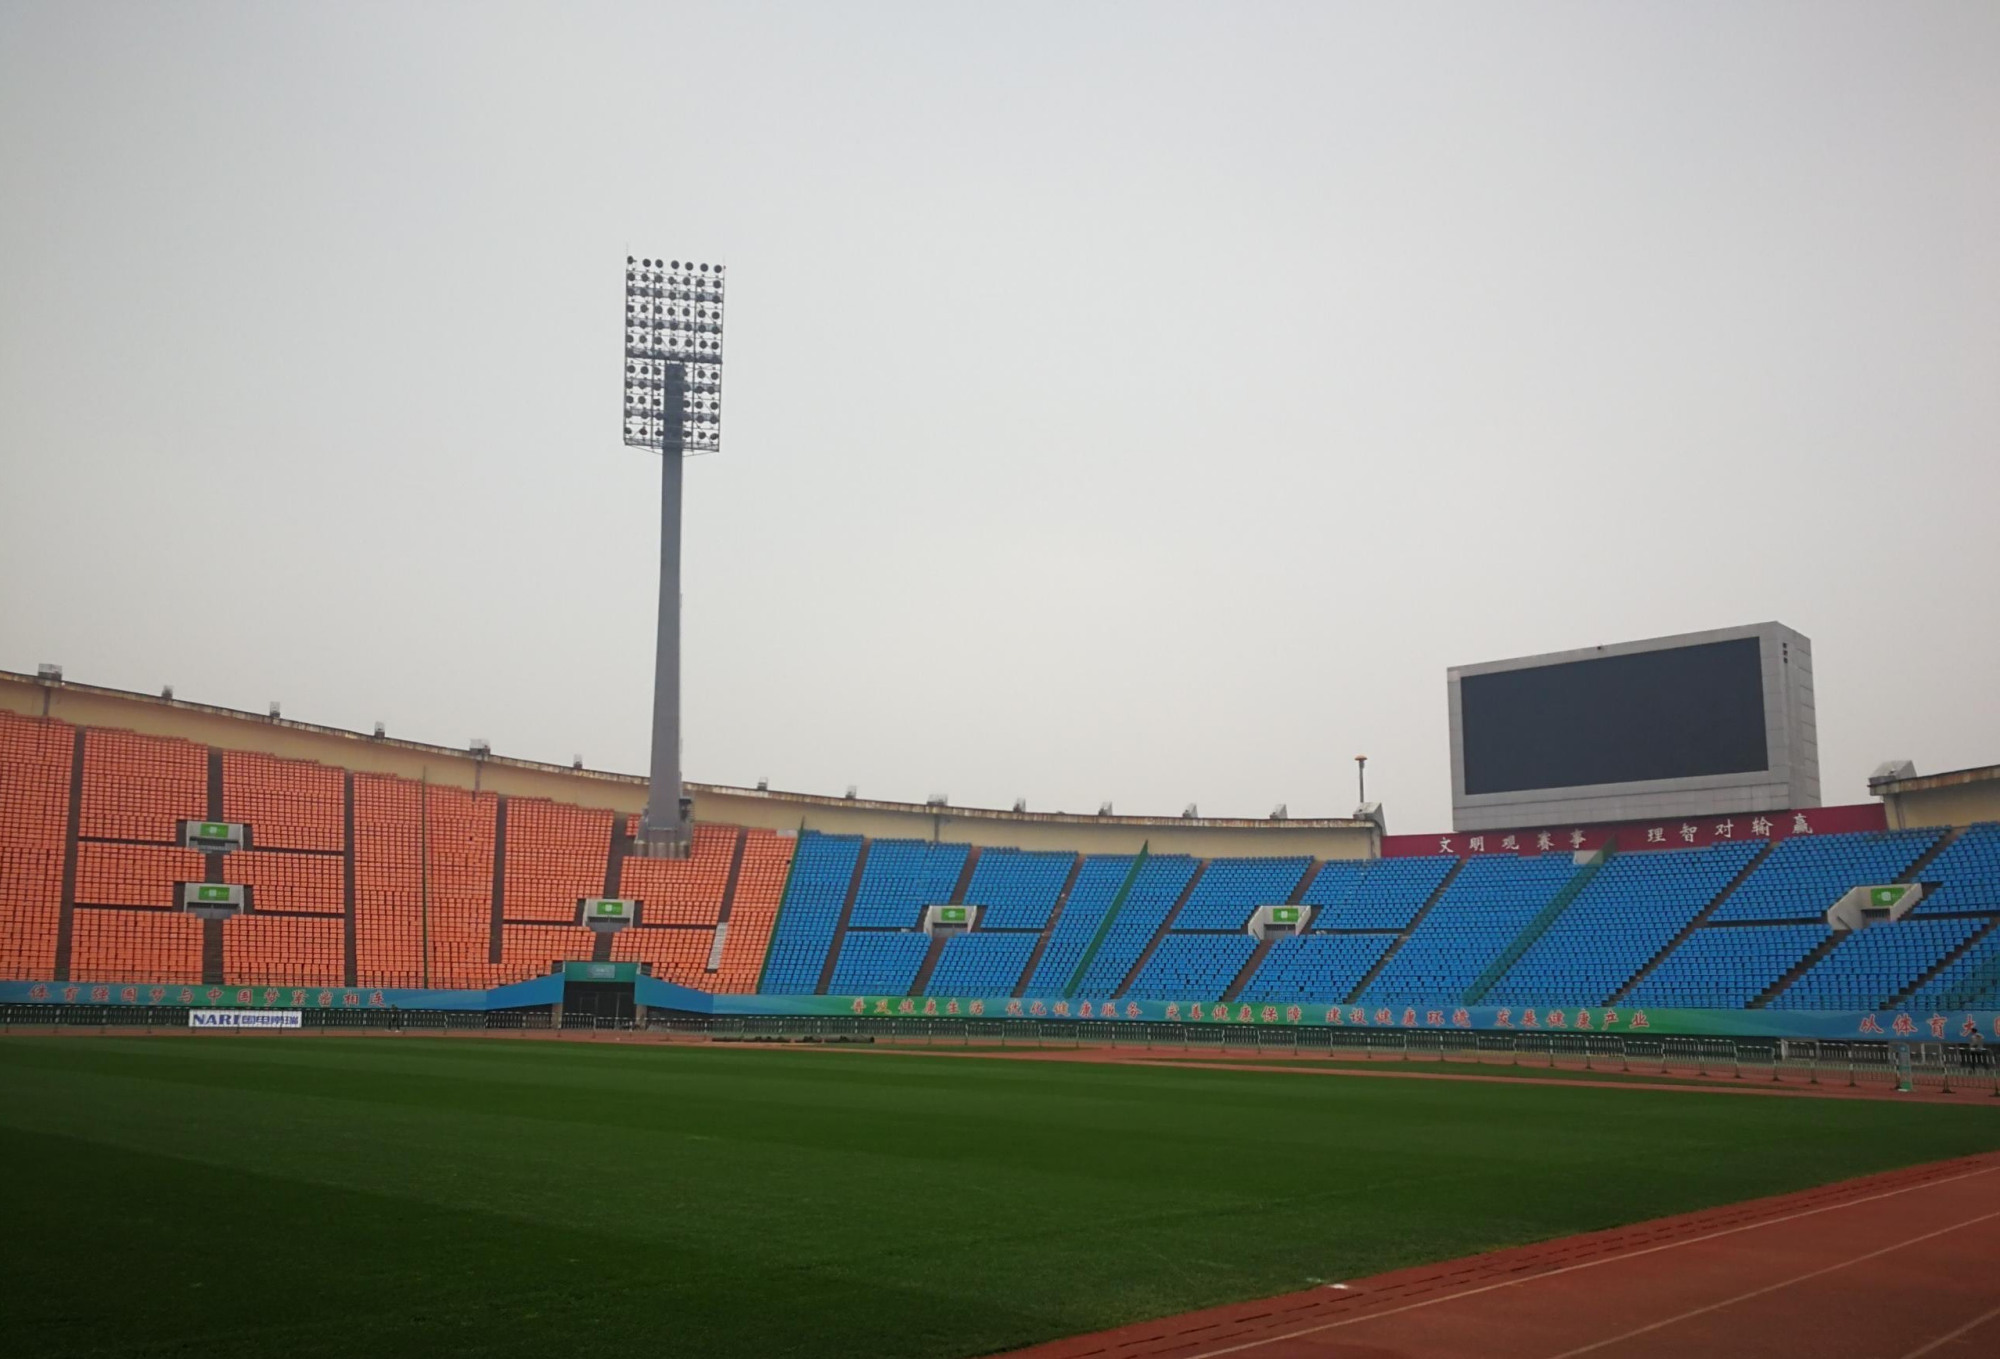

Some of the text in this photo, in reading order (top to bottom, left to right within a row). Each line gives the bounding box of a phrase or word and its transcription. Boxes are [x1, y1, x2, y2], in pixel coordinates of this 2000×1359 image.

[1439, 813, 1813, 853] 文明观赛事 理智对输赢
[29, 984, 385, 1007] 体育强国梦与中国梦紧密相连
[193, 1014, 239, 1025] NARI
[851, 998, 1649, 1030] 普及健康生活 优化健康服务 完善健康保障 建设健康环境 发展健康产业
